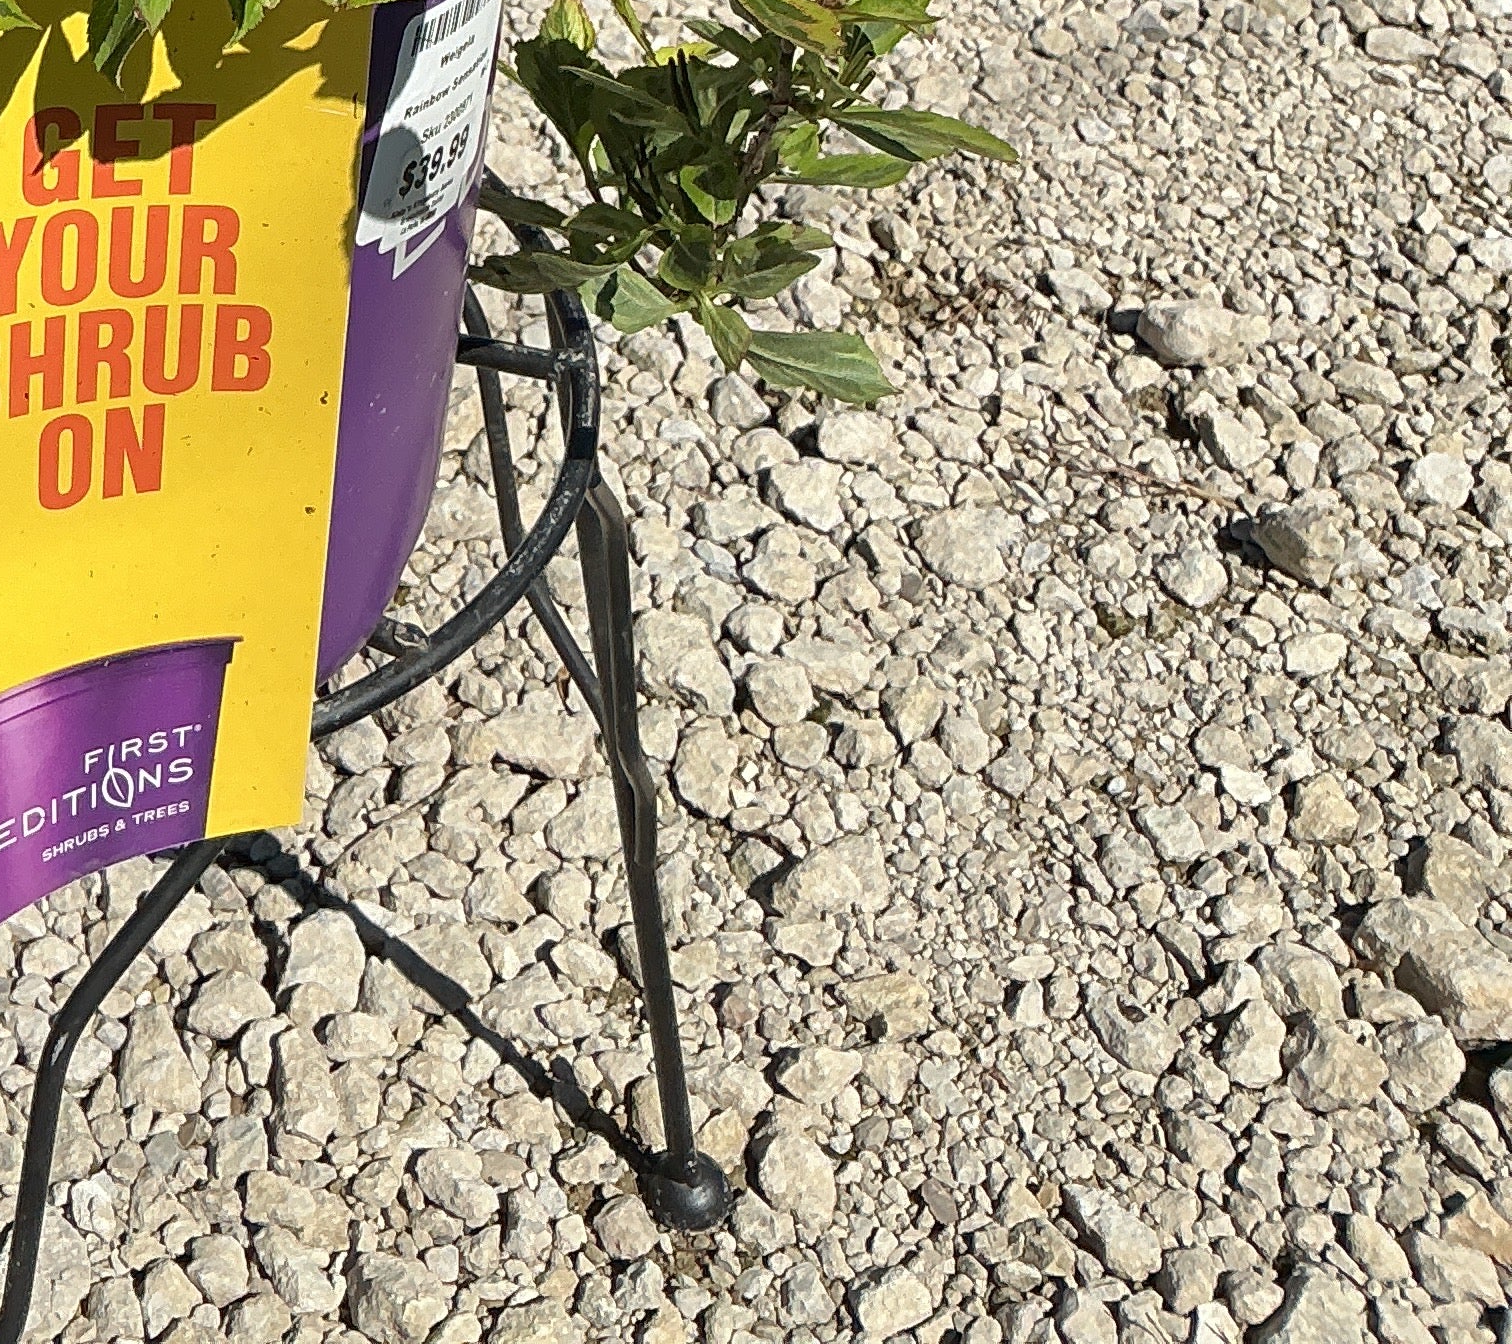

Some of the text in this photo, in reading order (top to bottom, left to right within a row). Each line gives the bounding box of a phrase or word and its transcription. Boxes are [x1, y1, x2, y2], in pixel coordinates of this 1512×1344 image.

[404, 85, 451, 120] Rainbow
[21, 102, 218, 207] GET
[399, 123, 470, 200] $39.99
[37, 403, 166, 510] ON
[42, 800, 190, 862] SHRUBS & TREES
